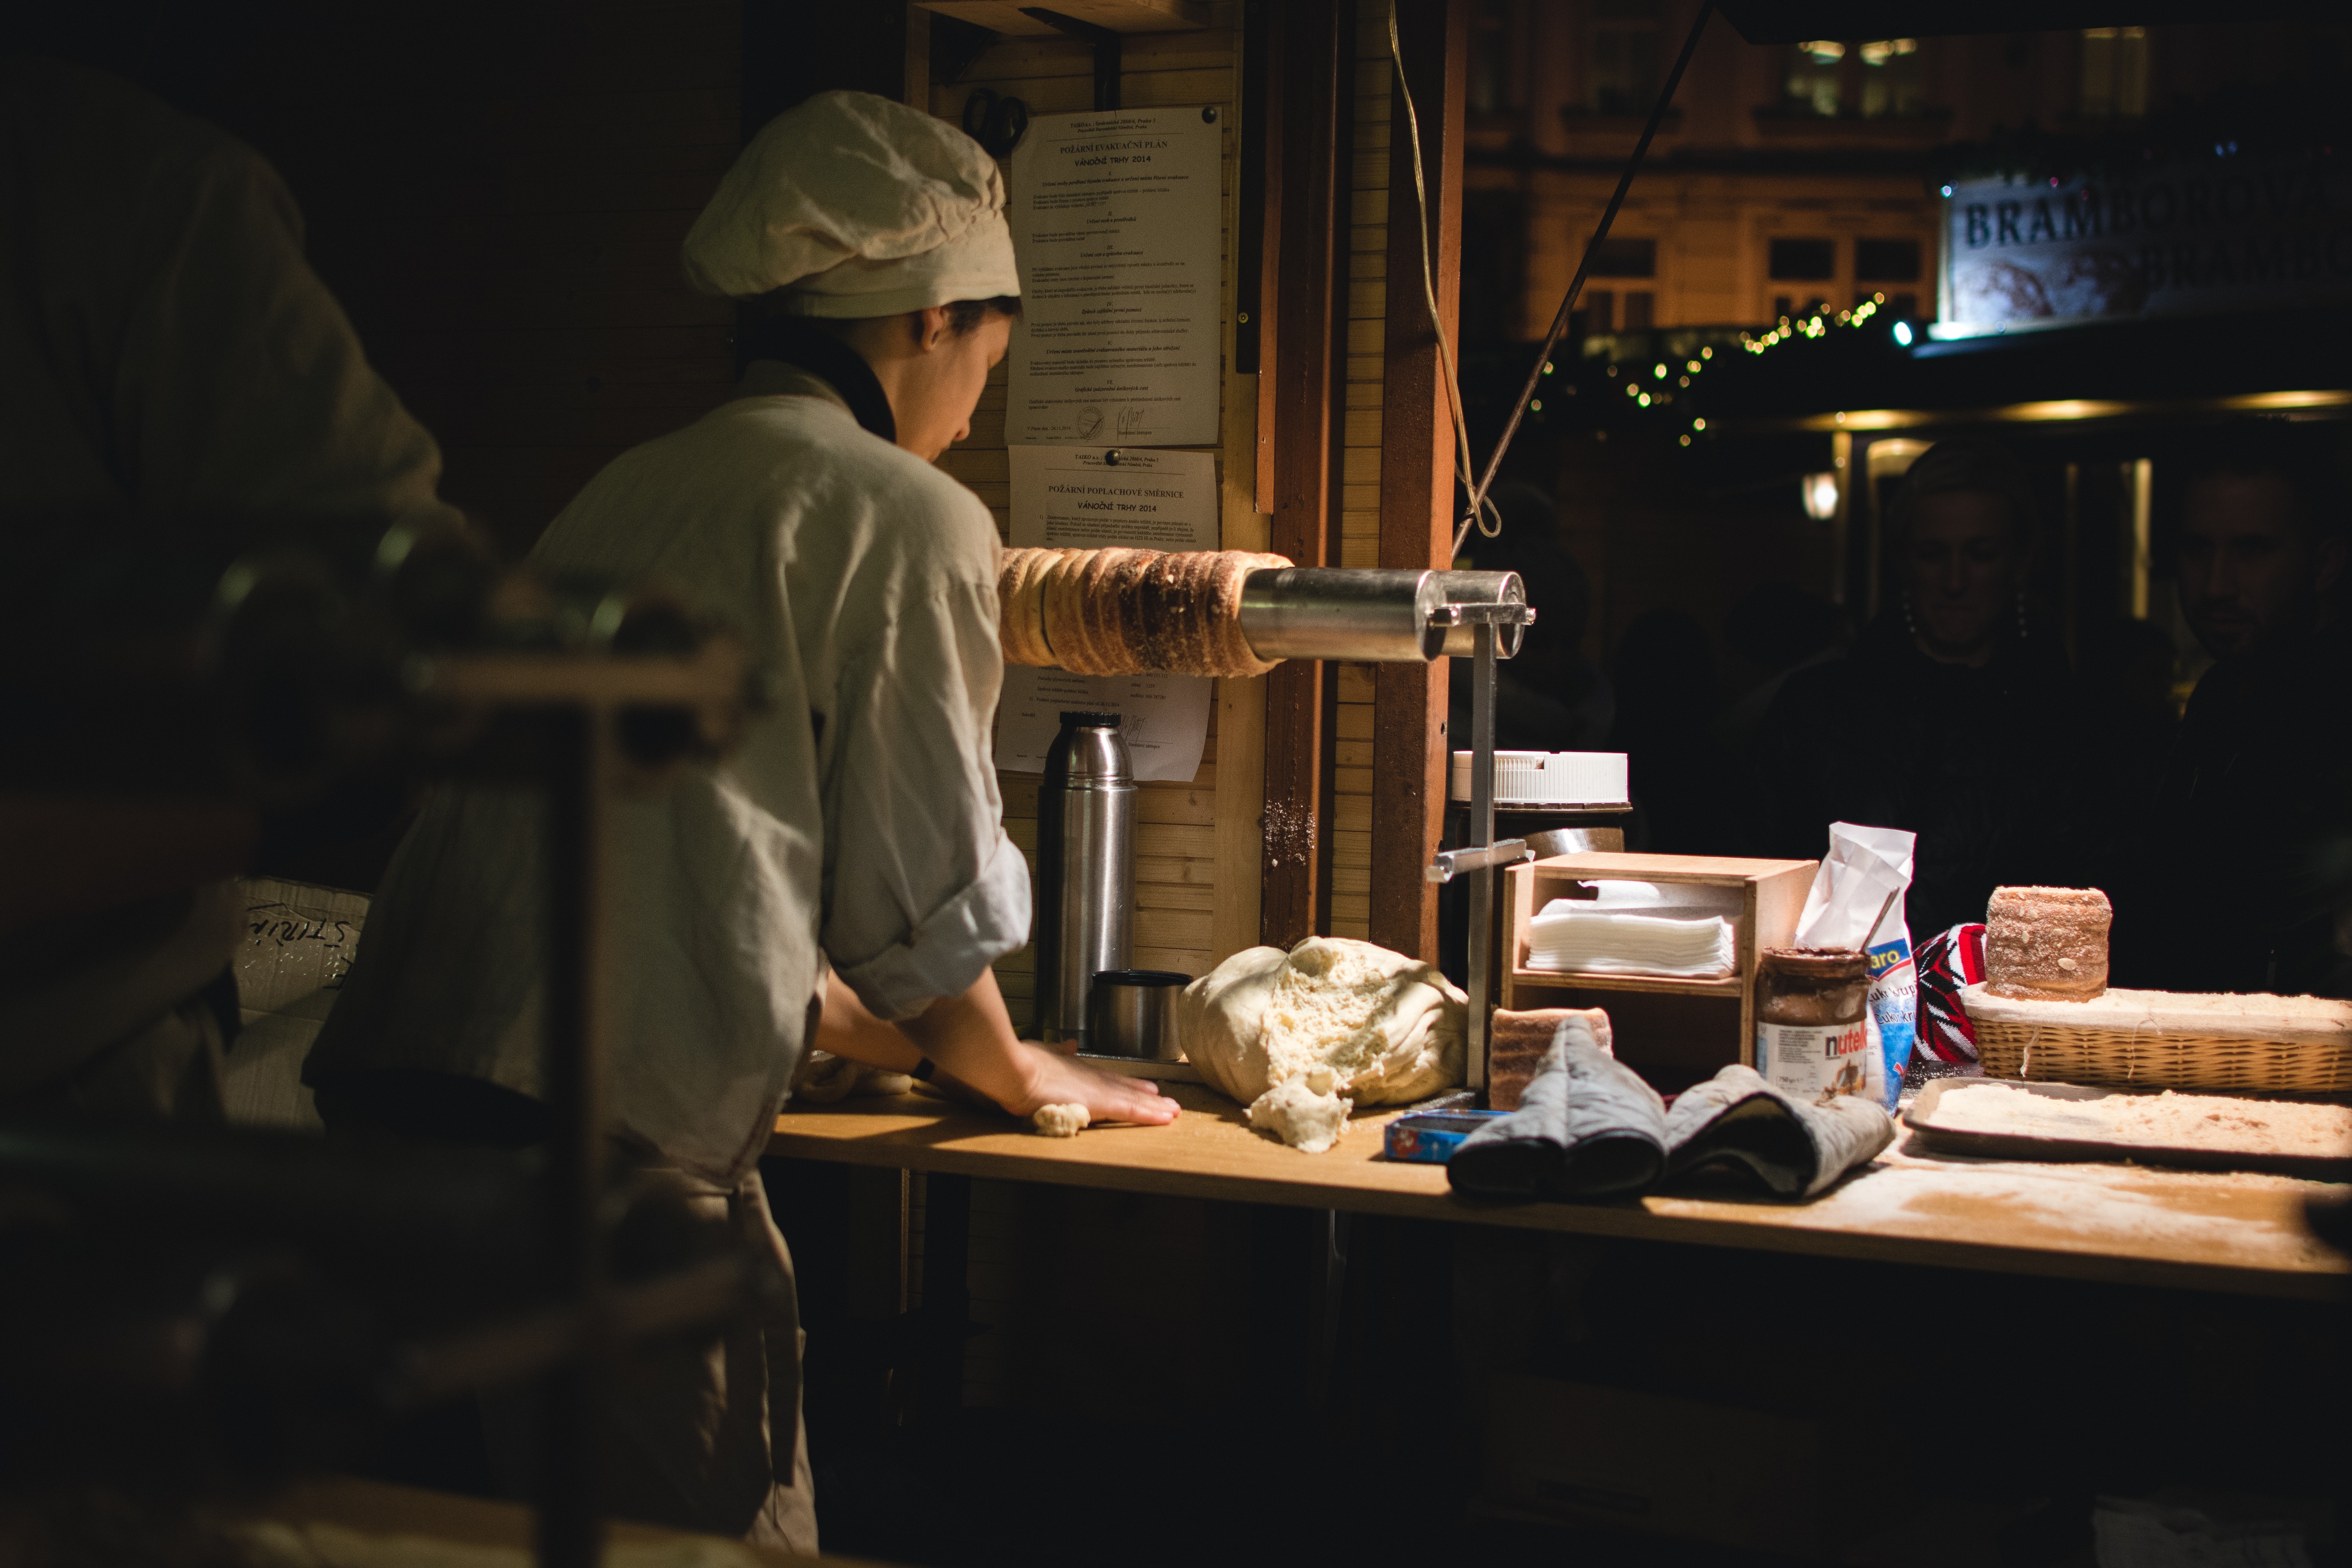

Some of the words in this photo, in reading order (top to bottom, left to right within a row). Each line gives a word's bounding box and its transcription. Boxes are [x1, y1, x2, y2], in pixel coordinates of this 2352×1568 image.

[1060, 143, 1093, 154] POŽÁRNÍ
[1096, 140, 1142, 151] EVAKUAČNÍ
[1145, 140, 1168, 149] PLÁN
[1074, 156, 1107, 166] VÁNOČNÍ
[1049, 484, 1085, 494] POŽÁRNÍ
[1087, 487, 1142, 496] POPLACHOVÉ
[1144, 488, 1184, 499] SMĚRNICE
[1078, 500, 1113, 510] VÁNOČNÍ
[1870, 950, 1900, 969] aro
[1888, 980, 1916, 998] krup
[1874, 1010, 1900, 1025] Cukor
